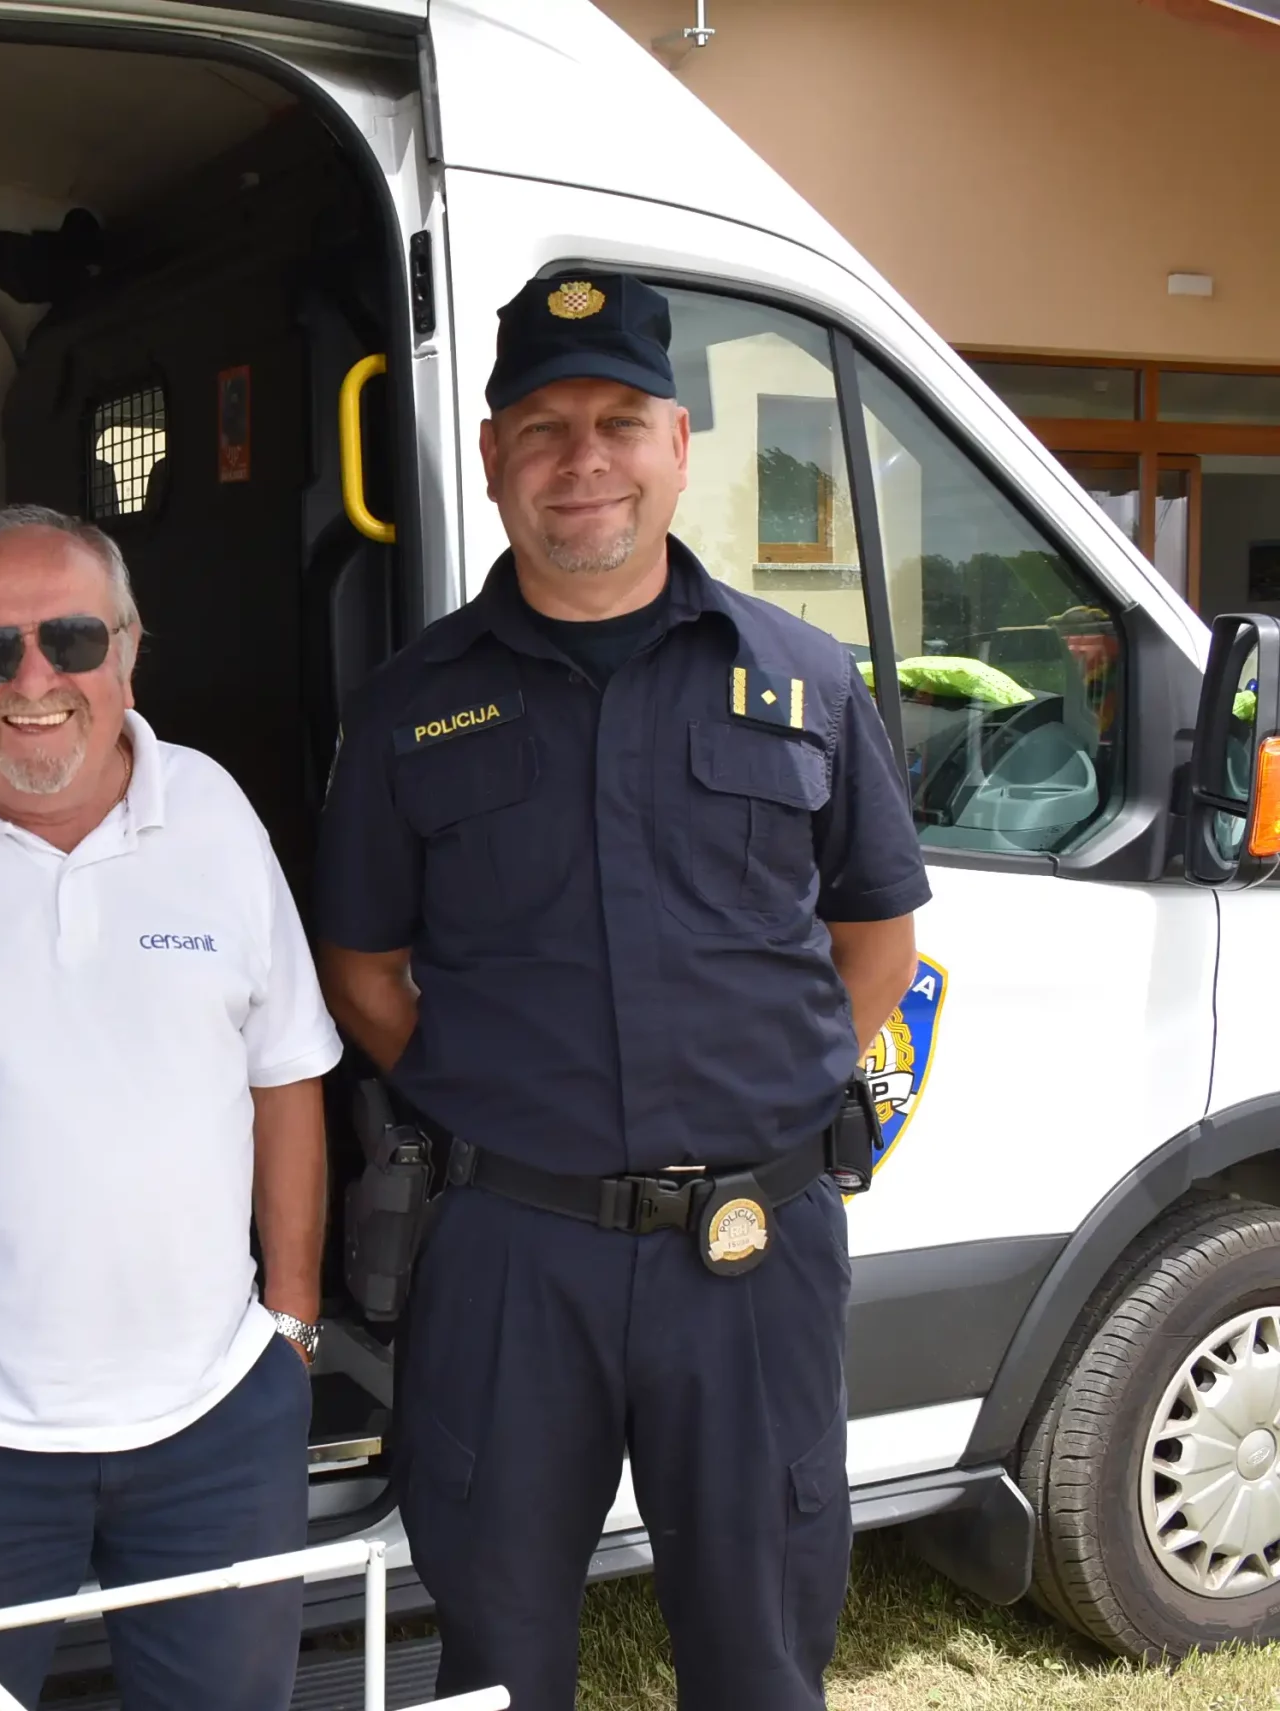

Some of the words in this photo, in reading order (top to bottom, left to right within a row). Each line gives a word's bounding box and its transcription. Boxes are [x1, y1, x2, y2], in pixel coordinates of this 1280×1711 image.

[414, 703, 500, 742] POLICIJA
[139, 933, 218, 952] cersanit
[719, 1209, 756, 1233] POLICIJA
